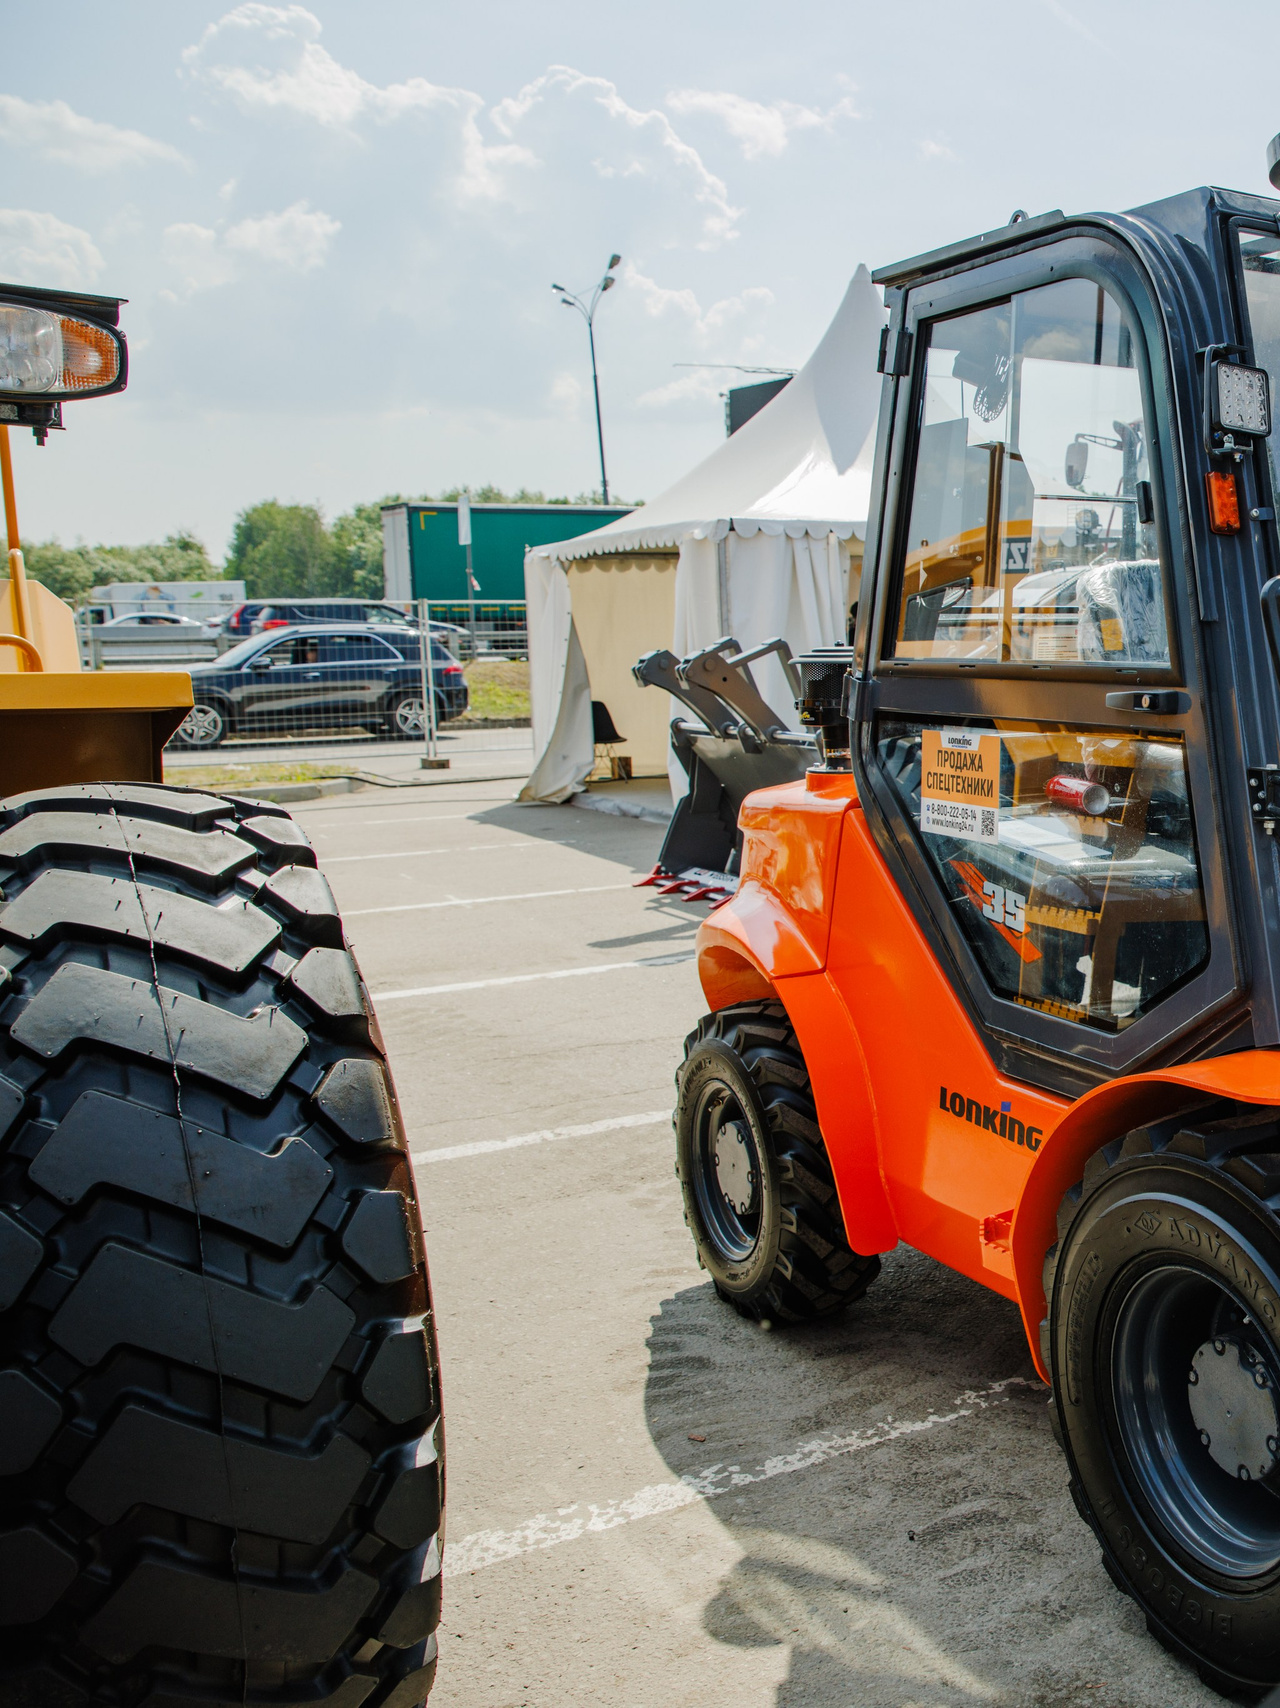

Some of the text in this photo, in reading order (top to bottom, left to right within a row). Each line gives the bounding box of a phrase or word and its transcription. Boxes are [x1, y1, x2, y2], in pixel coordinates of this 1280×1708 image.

[936, 749, 983, 773] ПРОДАЖА
[926, 771, 994, 798] СПЕЦТЕХНИКИ
[931, 803, 977, 821] 8-800-222-05-14
[931, 817, 974, 832] www.lonking24.ru
[982, 880, 1026, 934] 35
